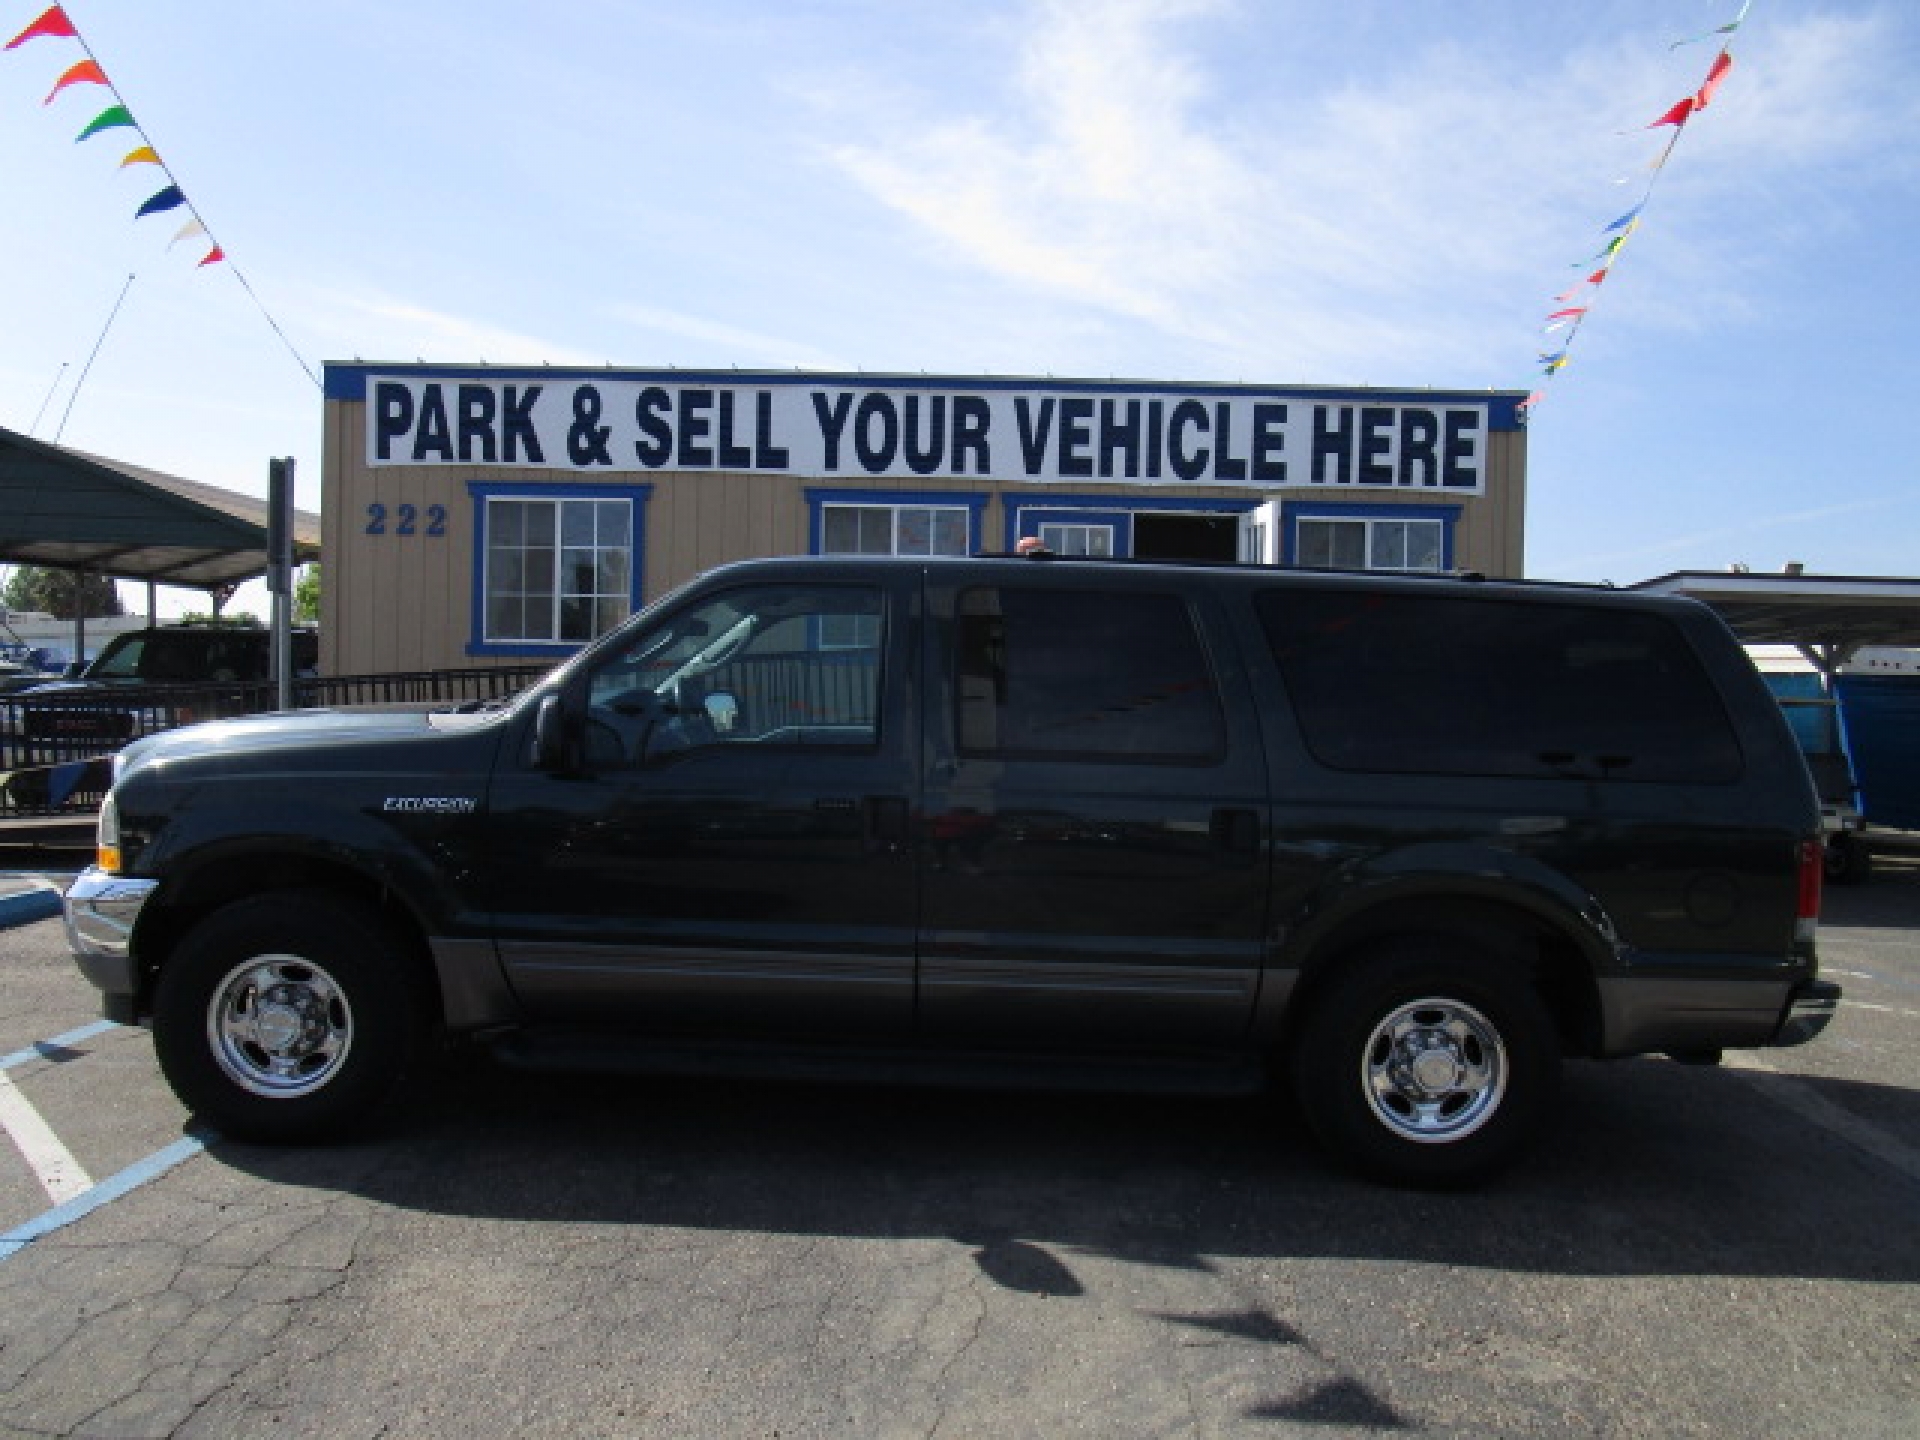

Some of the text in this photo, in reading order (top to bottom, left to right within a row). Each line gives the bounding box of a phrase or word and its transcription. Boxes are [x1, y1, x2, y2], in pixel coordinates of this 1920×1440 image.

[374, 380, 1481, 489] PARK & SELL YOUR VEHICLE HERE
[365, 503, 447, 537] 222
